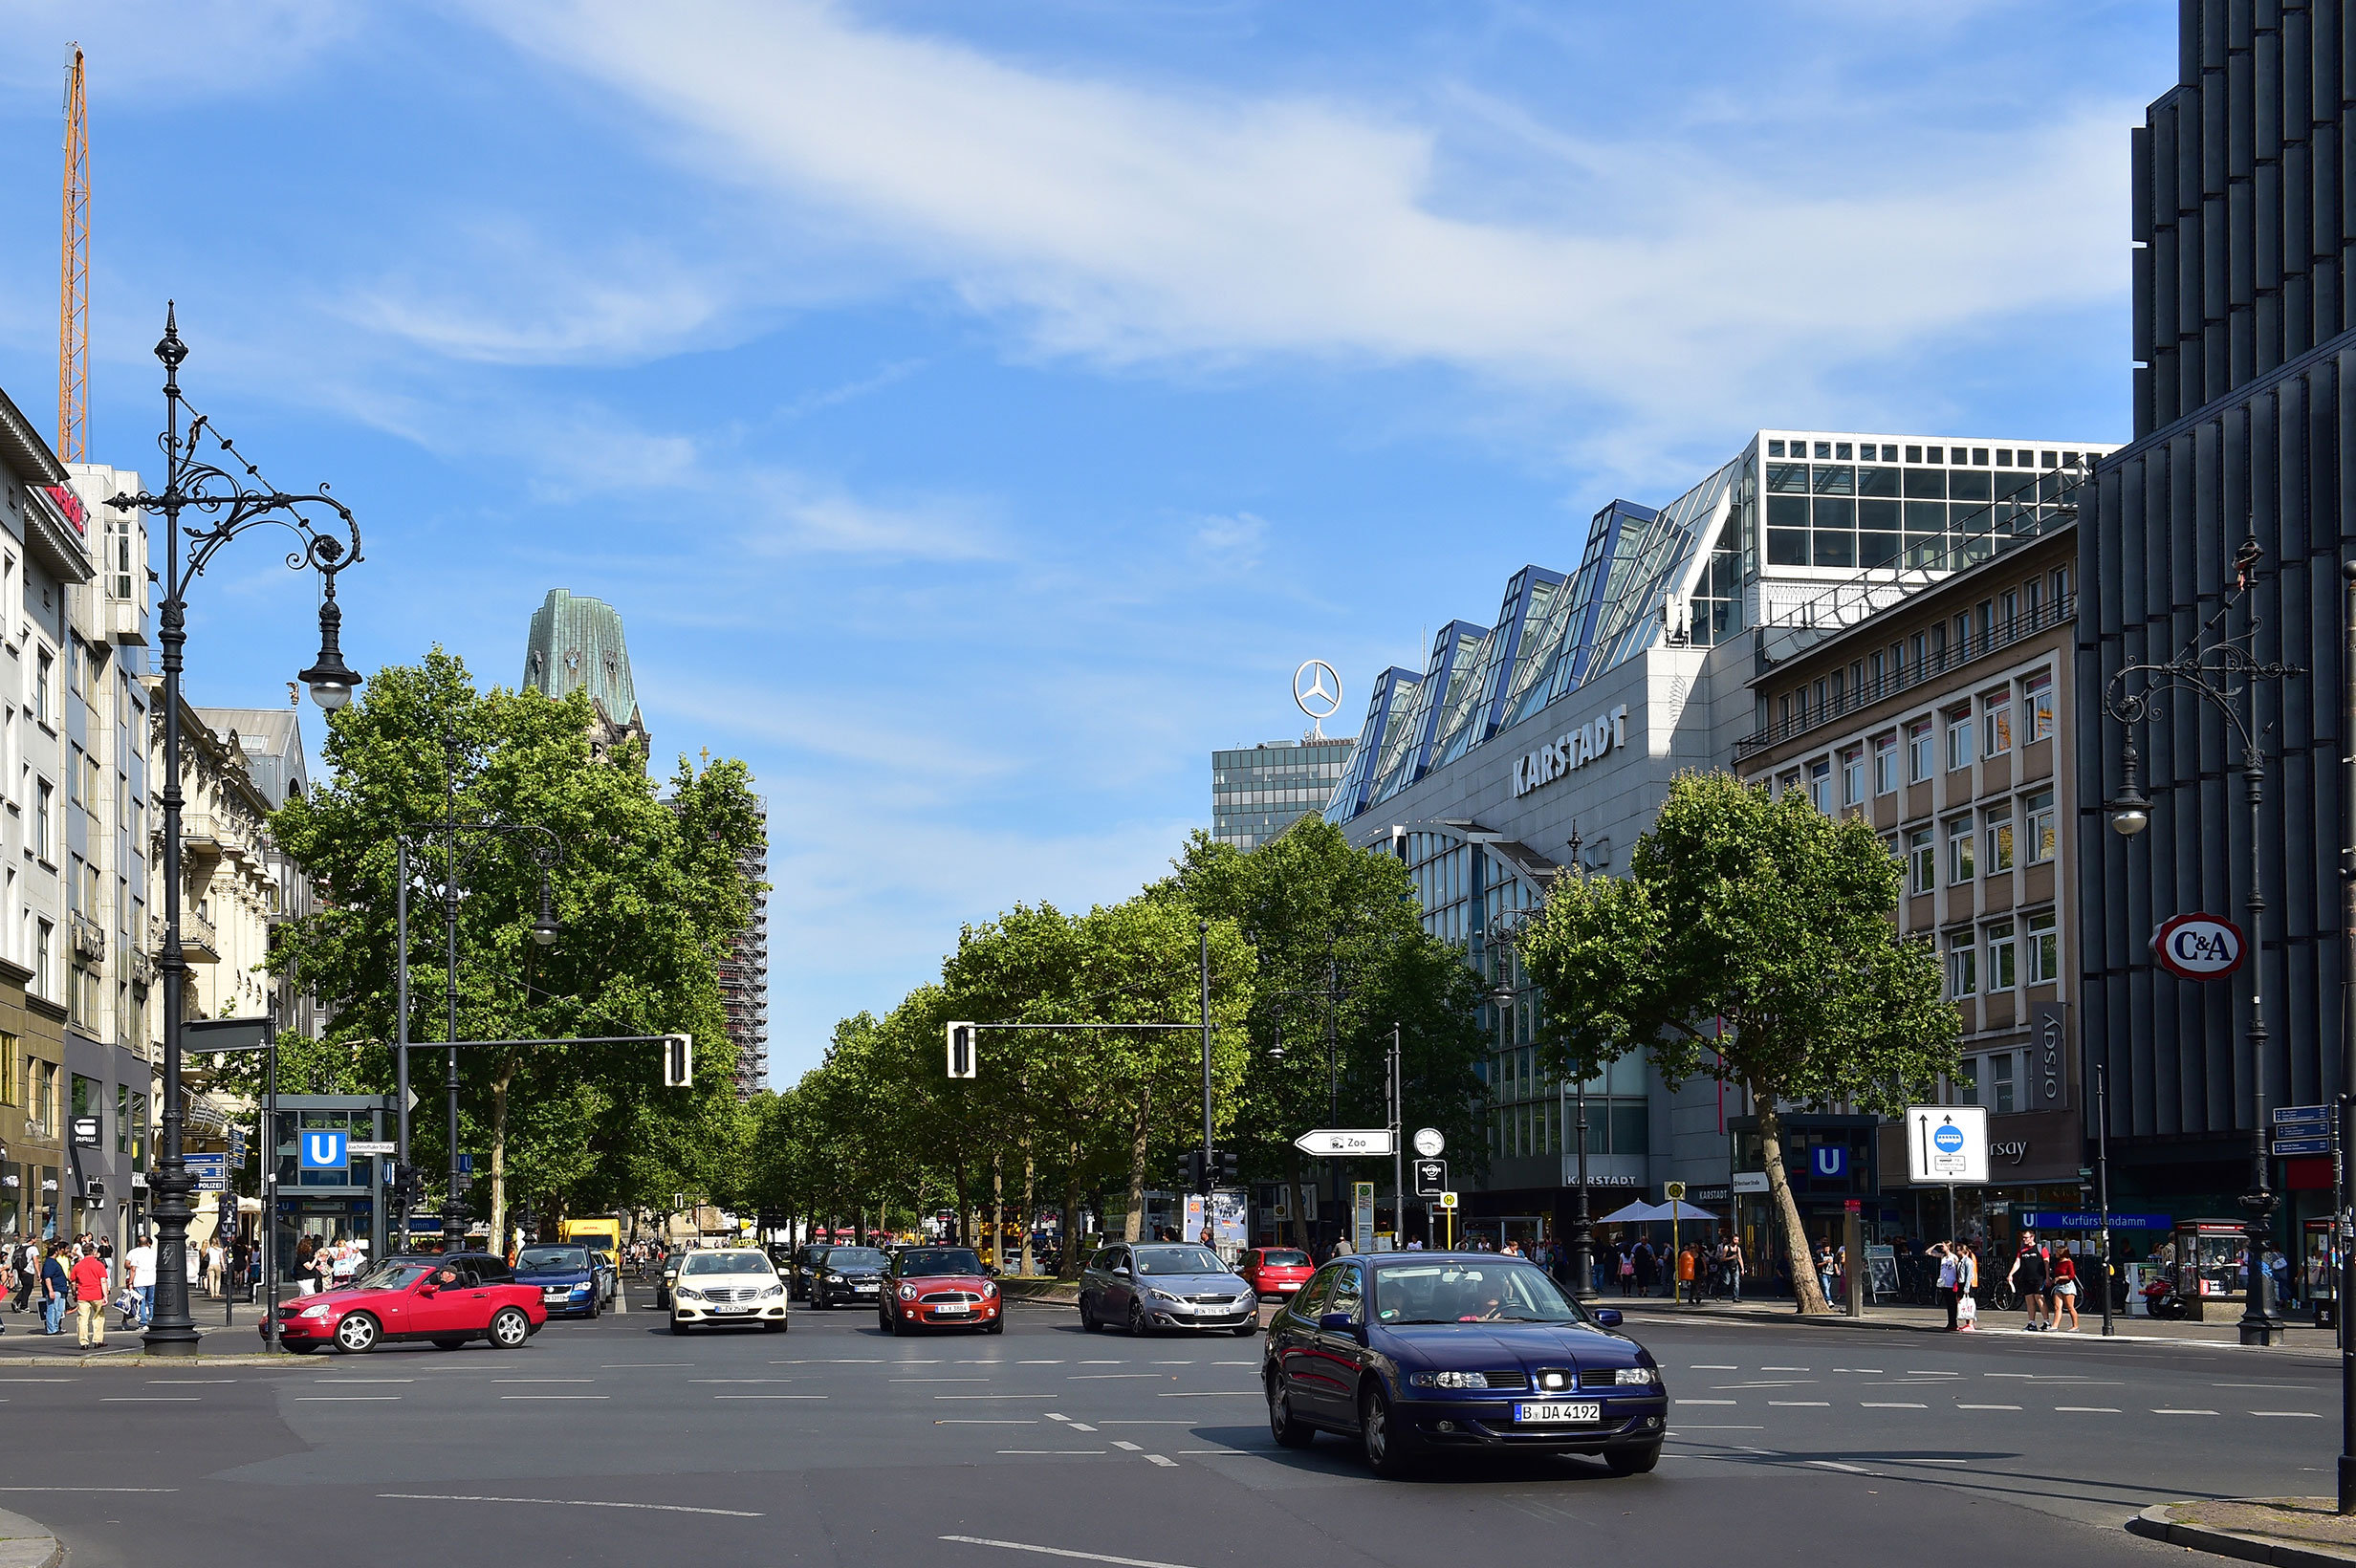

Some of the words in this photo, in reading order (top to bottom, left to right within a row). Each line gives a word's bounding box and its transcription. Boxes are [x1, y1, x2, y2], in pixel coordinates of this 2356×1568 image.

[1513, 704, 1626, 799] KARSTADT
[2174, 930, 2232, 962] C&A
[2043, 1013, 2063, 1099] orsay
[311, 1135, 337, 1165] U
[1347, 1138, 1366, 1147] Zoo
[1819, 1149, 1840, 1174] U
[1990, 1141, 2026, 1164] rsay
[465, 1155, 471, 1170] U
[383, 1164, 390, 1182] U
[1568, 1175, 1636, 1185] KRSTADT
[1698, 1189, 1728, 1200] KARSTADT
[2022, 1213, 2035, 1228] U
[2062, 1215, 2146, 1227] Kurfürstndamm
[1522, 1406, 1532, 1419] B
[1541, 1406, 1560, 1419] DA
[1563, 1405, 1599, 1419] 4192
